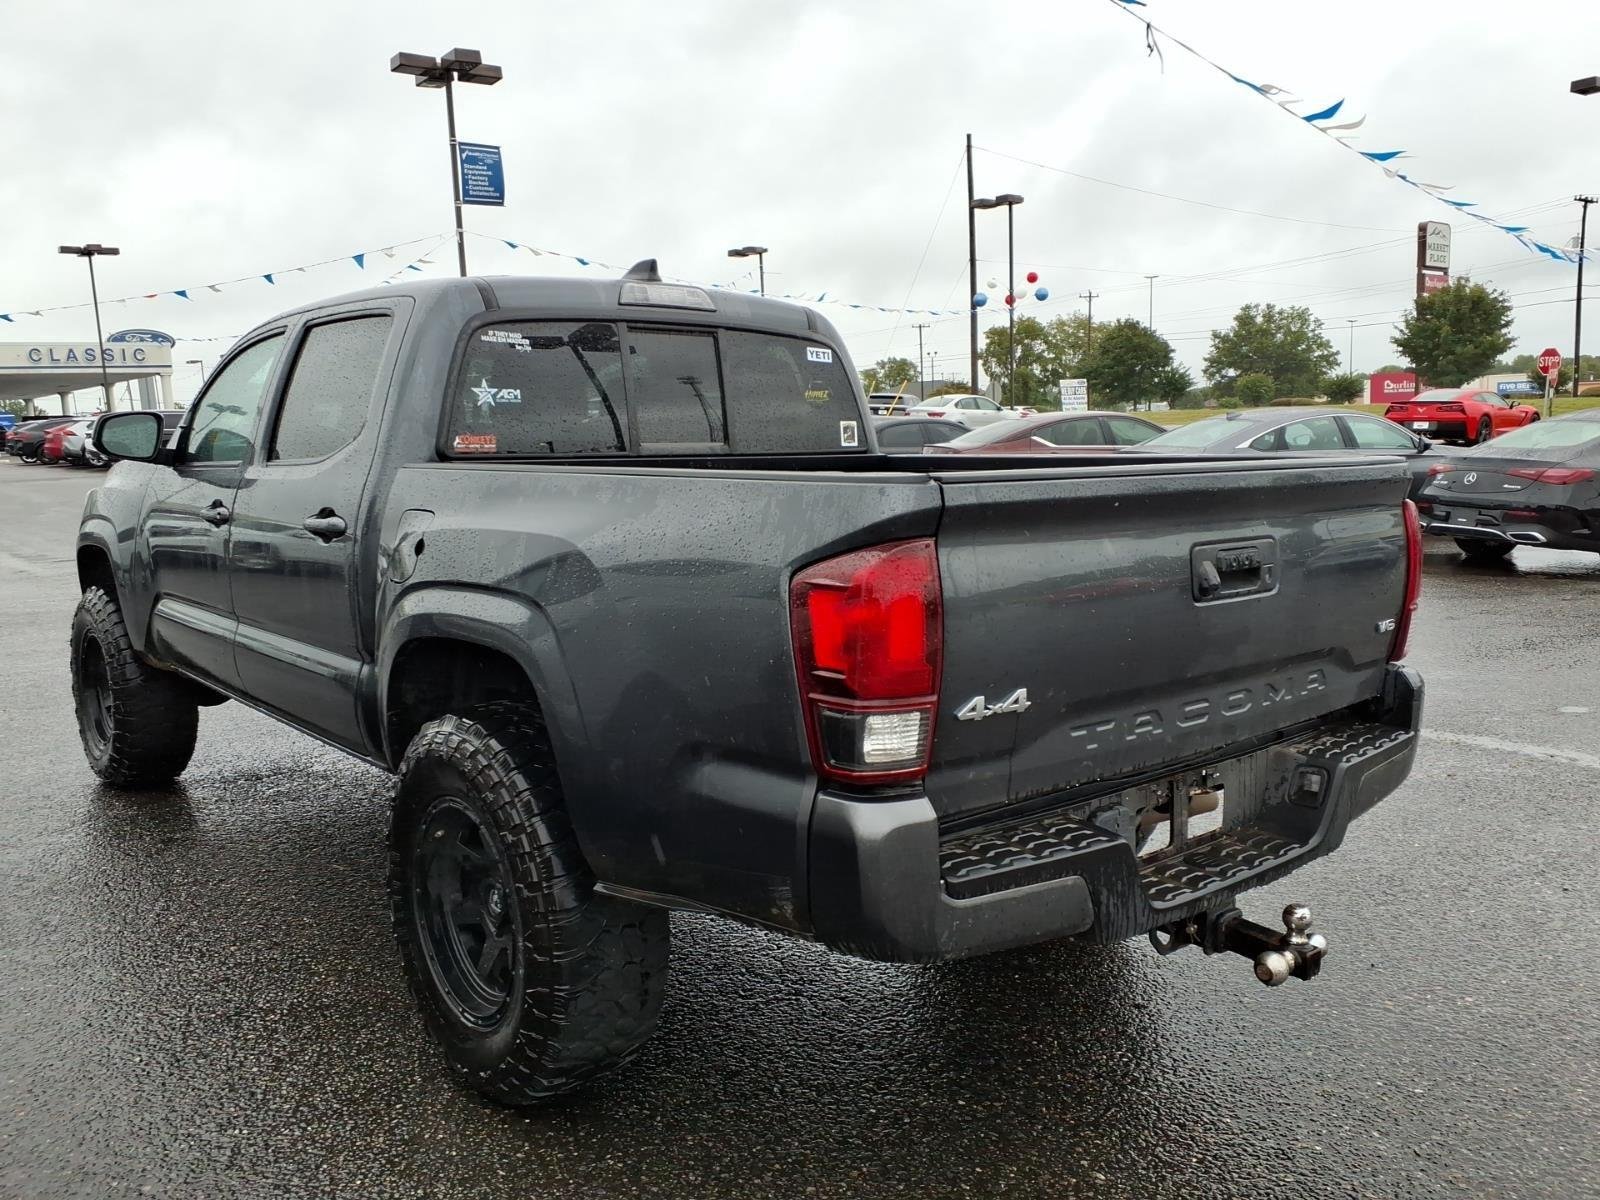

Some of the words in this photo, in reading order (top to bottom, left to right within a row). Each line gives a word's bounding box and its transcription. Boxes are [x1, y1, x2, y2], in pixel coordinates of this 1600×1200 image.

[1429, 253, 1447, 263] PLACE
[28, 348, 147, 362] CLASSIC
[808, 350, 831, 361] YETI
[1539, 356, 1559, 367] STOP
[496, 389, 521, 399] AGM
[1377, 618, 1396, 632] V6
[954, 688, 1031, 720] 4x4
[1070, 668, 1327, 749] TACOMA
